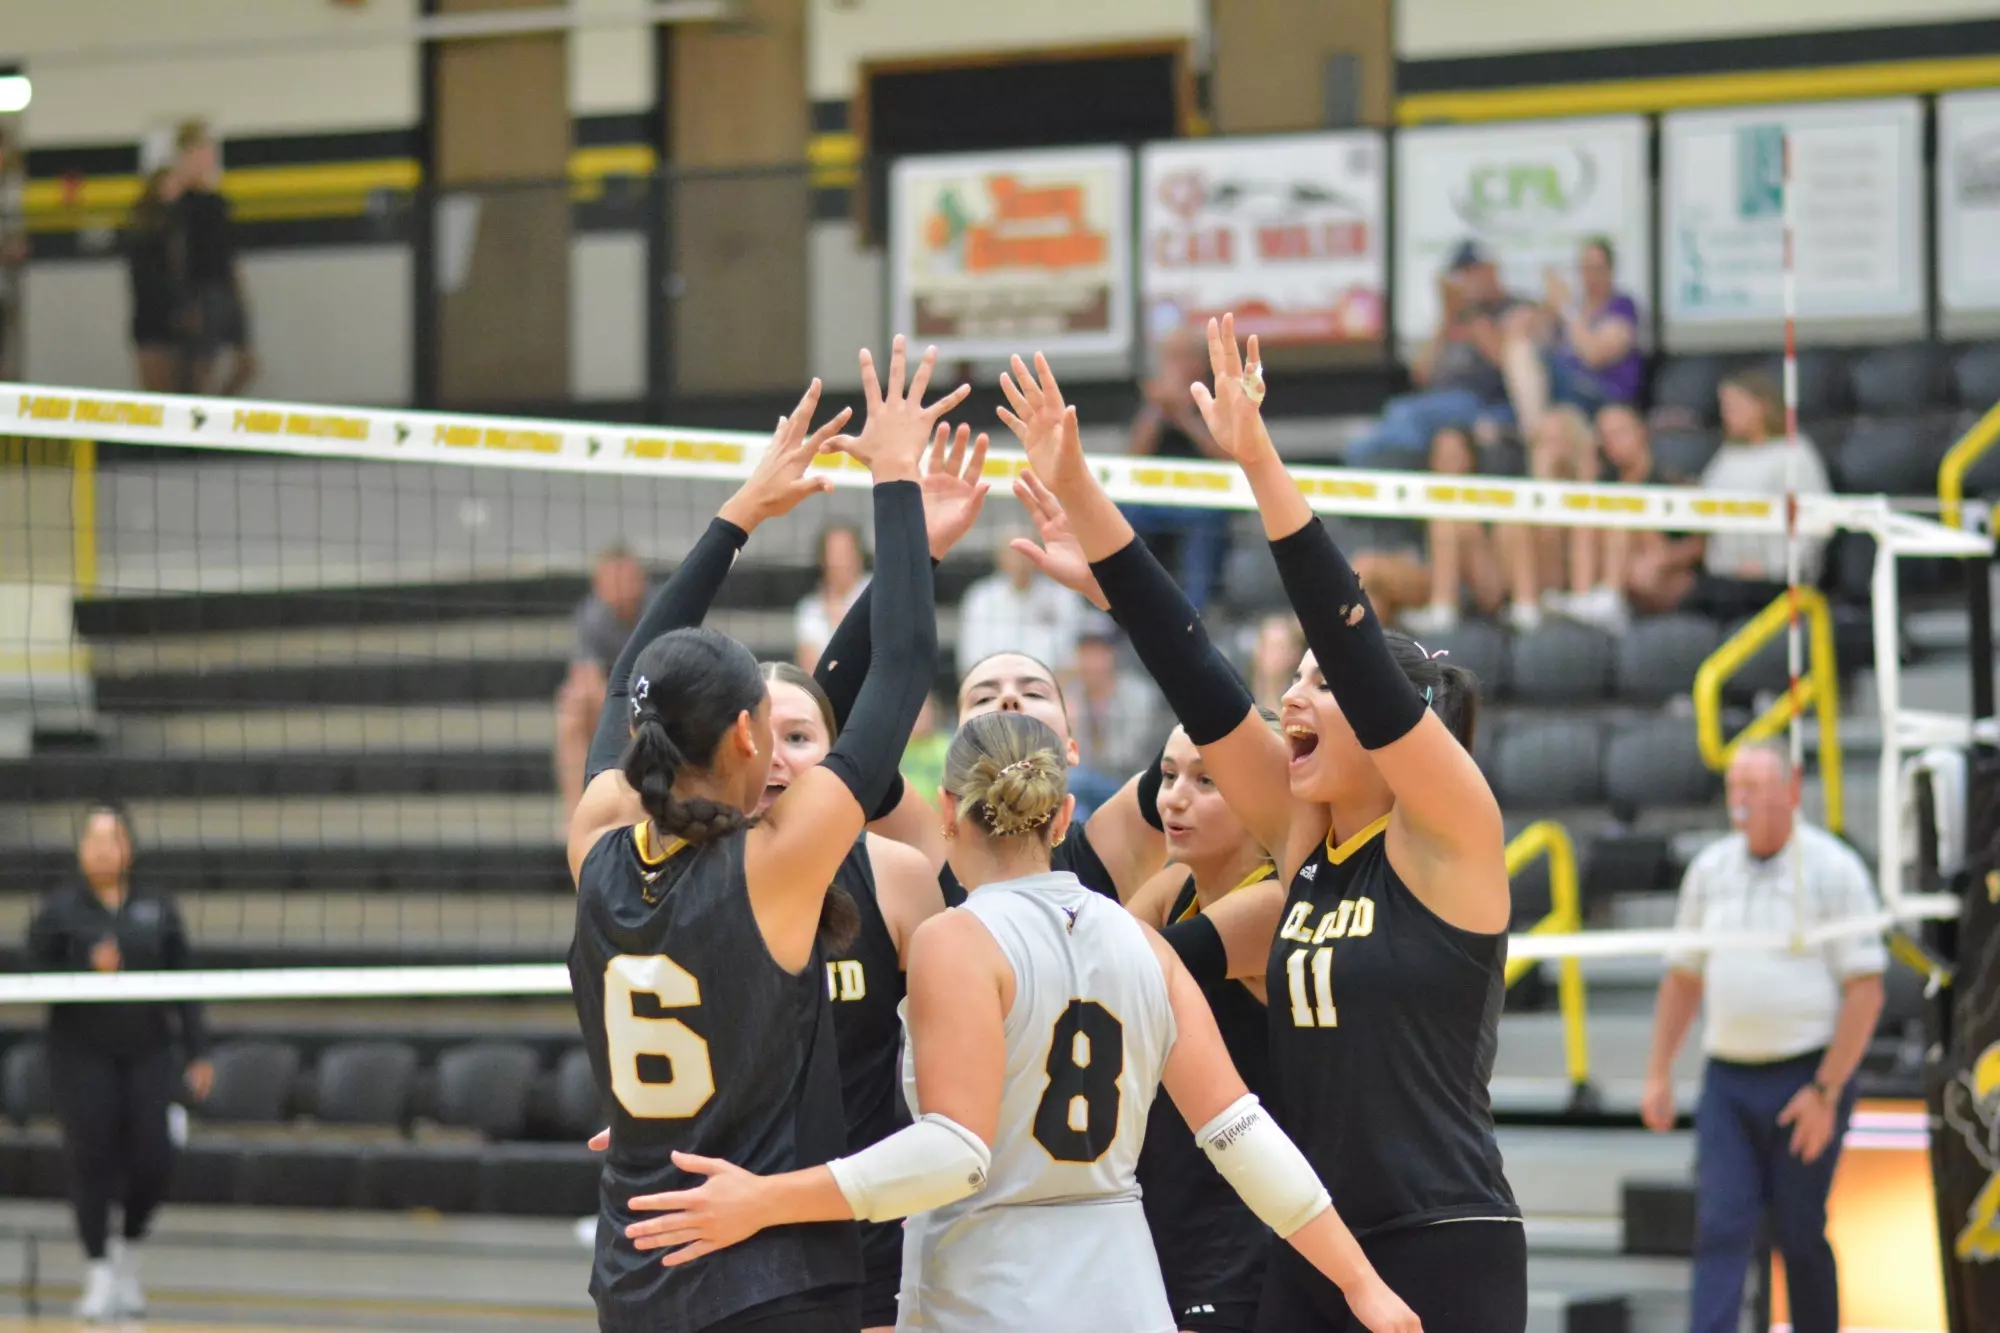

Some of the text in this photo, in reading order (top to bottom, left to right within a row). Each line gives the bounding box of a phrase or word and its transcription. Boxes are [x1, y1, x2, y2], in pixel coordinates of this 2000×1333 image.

[603, 953, 716, 1119] 6
[1286, 947, 1338, 1028] 11
[1032, 998, 1124, 1166] 8
